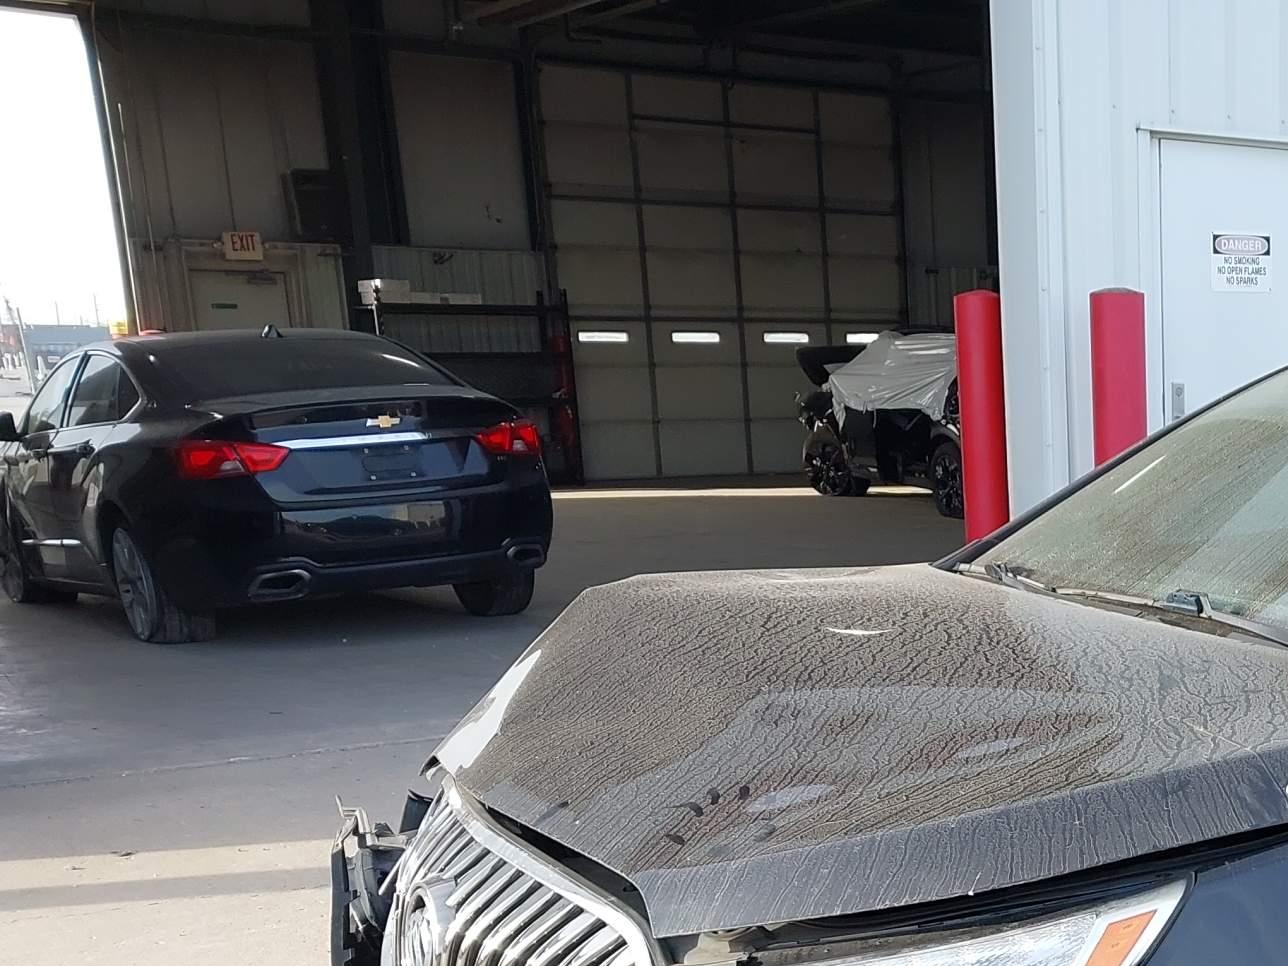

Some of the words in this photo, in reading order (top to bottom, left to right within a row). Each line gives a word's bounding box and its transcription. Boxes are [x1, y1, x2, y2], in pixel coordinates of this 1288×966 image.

[231, 234, 256, 251] EXIT
[1221, 239, 1262, 251] DANGER
[1224, 256, 1233, 265] NO
[1234, 256, 1260, 265] SMOKING
[1217, 266, 1226, 274] NO
[1227, 266, 1242, 275] OPEN
[1244, 266, 1266, 276] FLAMES
[1226, 276, 1235, 285] NO
[1236, 276, 1258, 286] SPARKS
